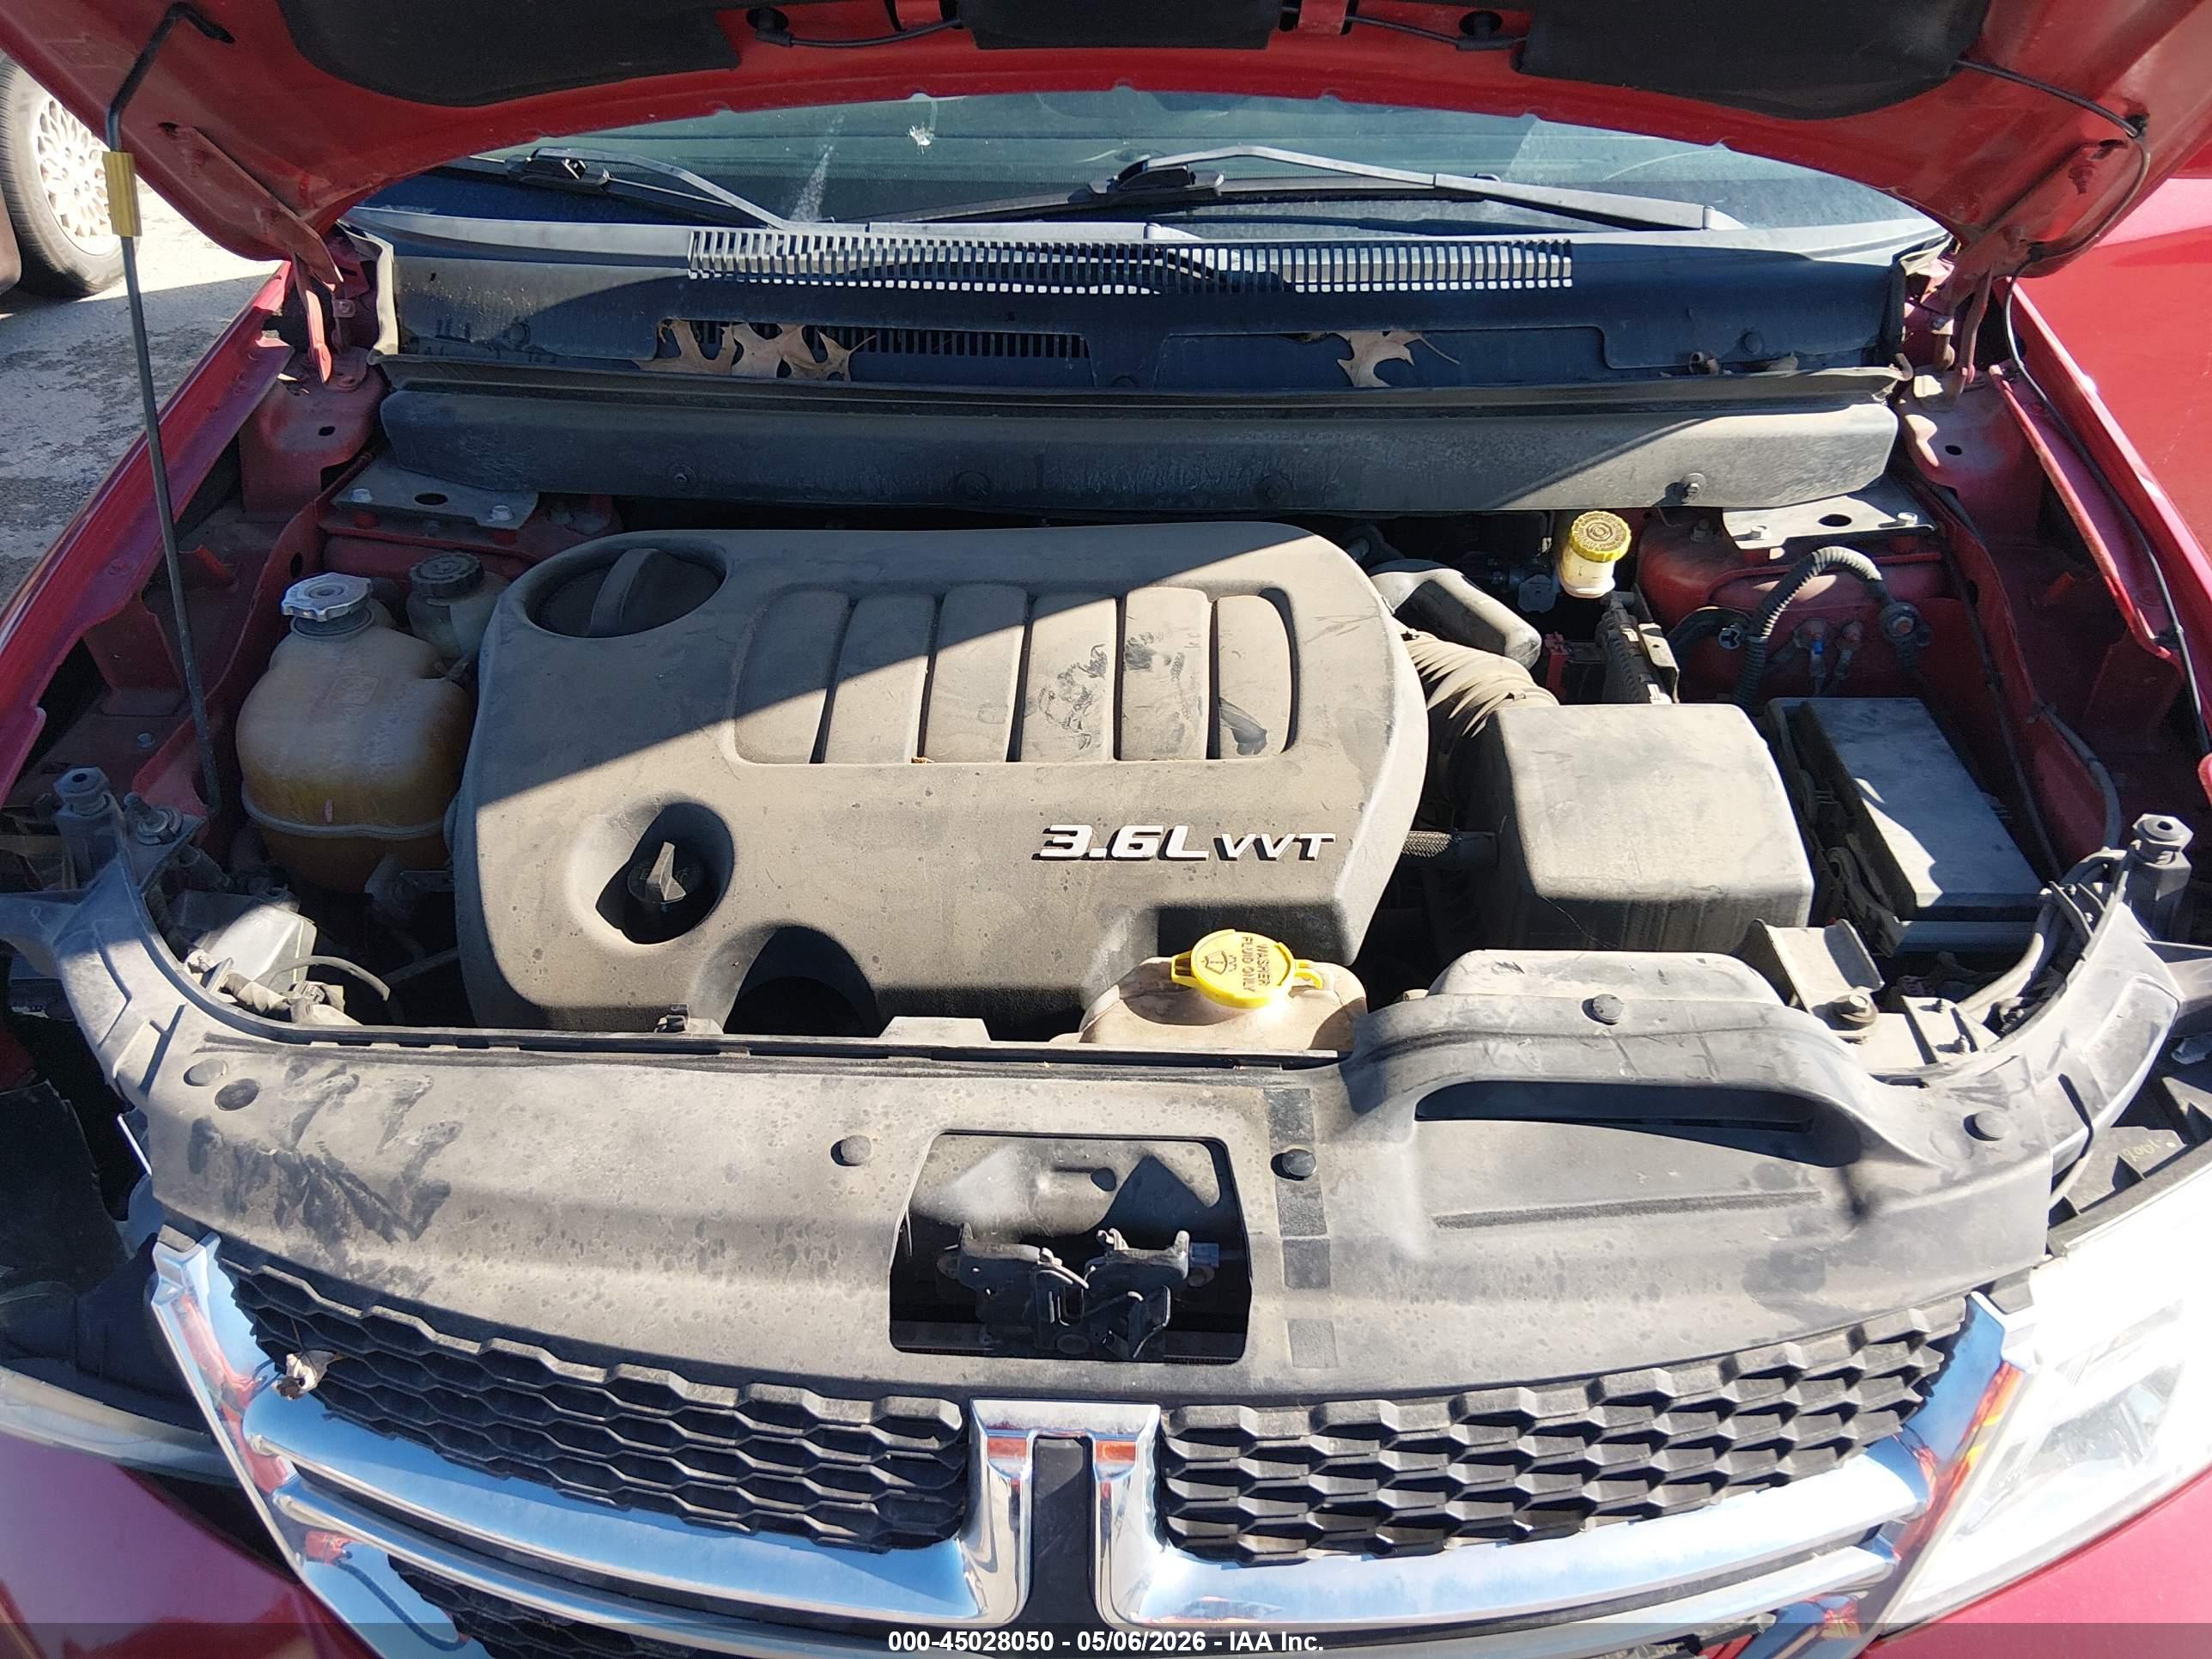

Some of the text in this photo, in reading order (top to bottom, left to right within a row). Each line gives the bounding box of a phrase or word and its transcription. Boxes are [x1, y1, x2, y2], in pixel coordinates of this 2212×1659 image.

[1034, 823, 1336, 861] 3.6L VVT
[1242, 936, 1256, 993] FLUID ONLY
[1256, 944, 1271, 986] WASHER
